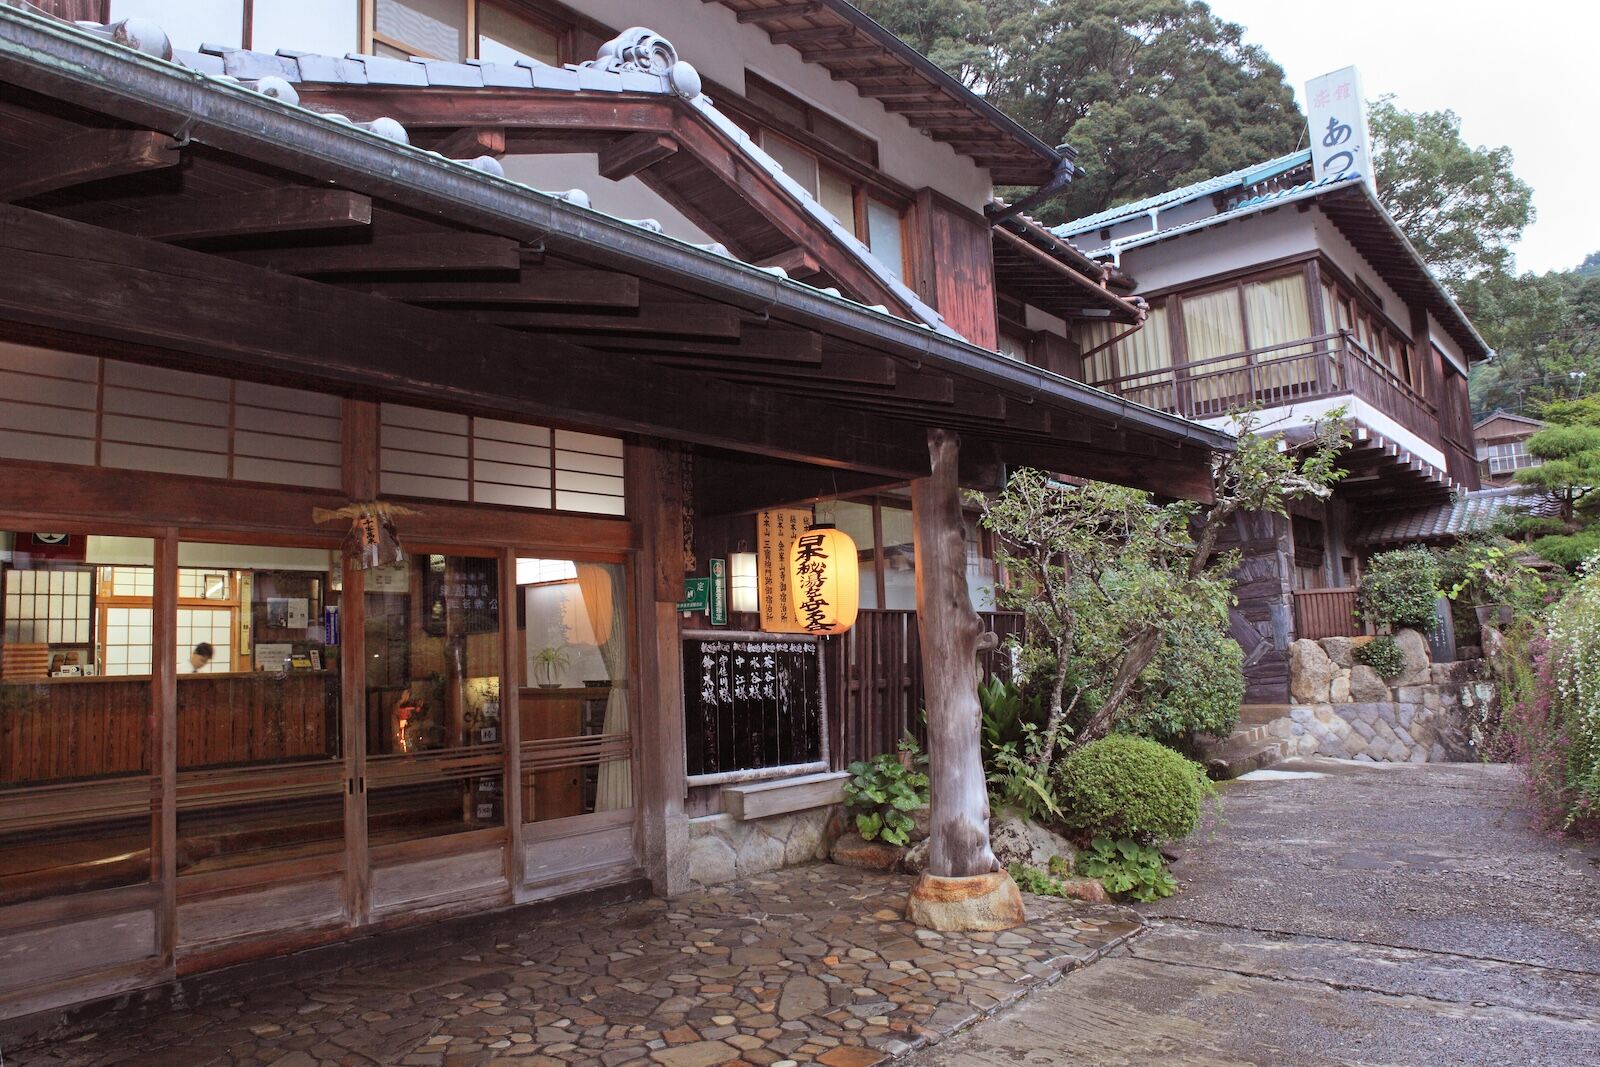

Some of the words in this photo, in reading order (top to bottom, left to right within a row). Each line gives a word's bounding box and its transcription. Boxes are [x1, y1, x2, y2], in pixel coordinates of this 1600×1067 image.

[795, 534, 837, 631] 日本秘湯を守る会
[734, 655, 748, 701] 中江様
[748, 656, 763, 701] 水谷様
